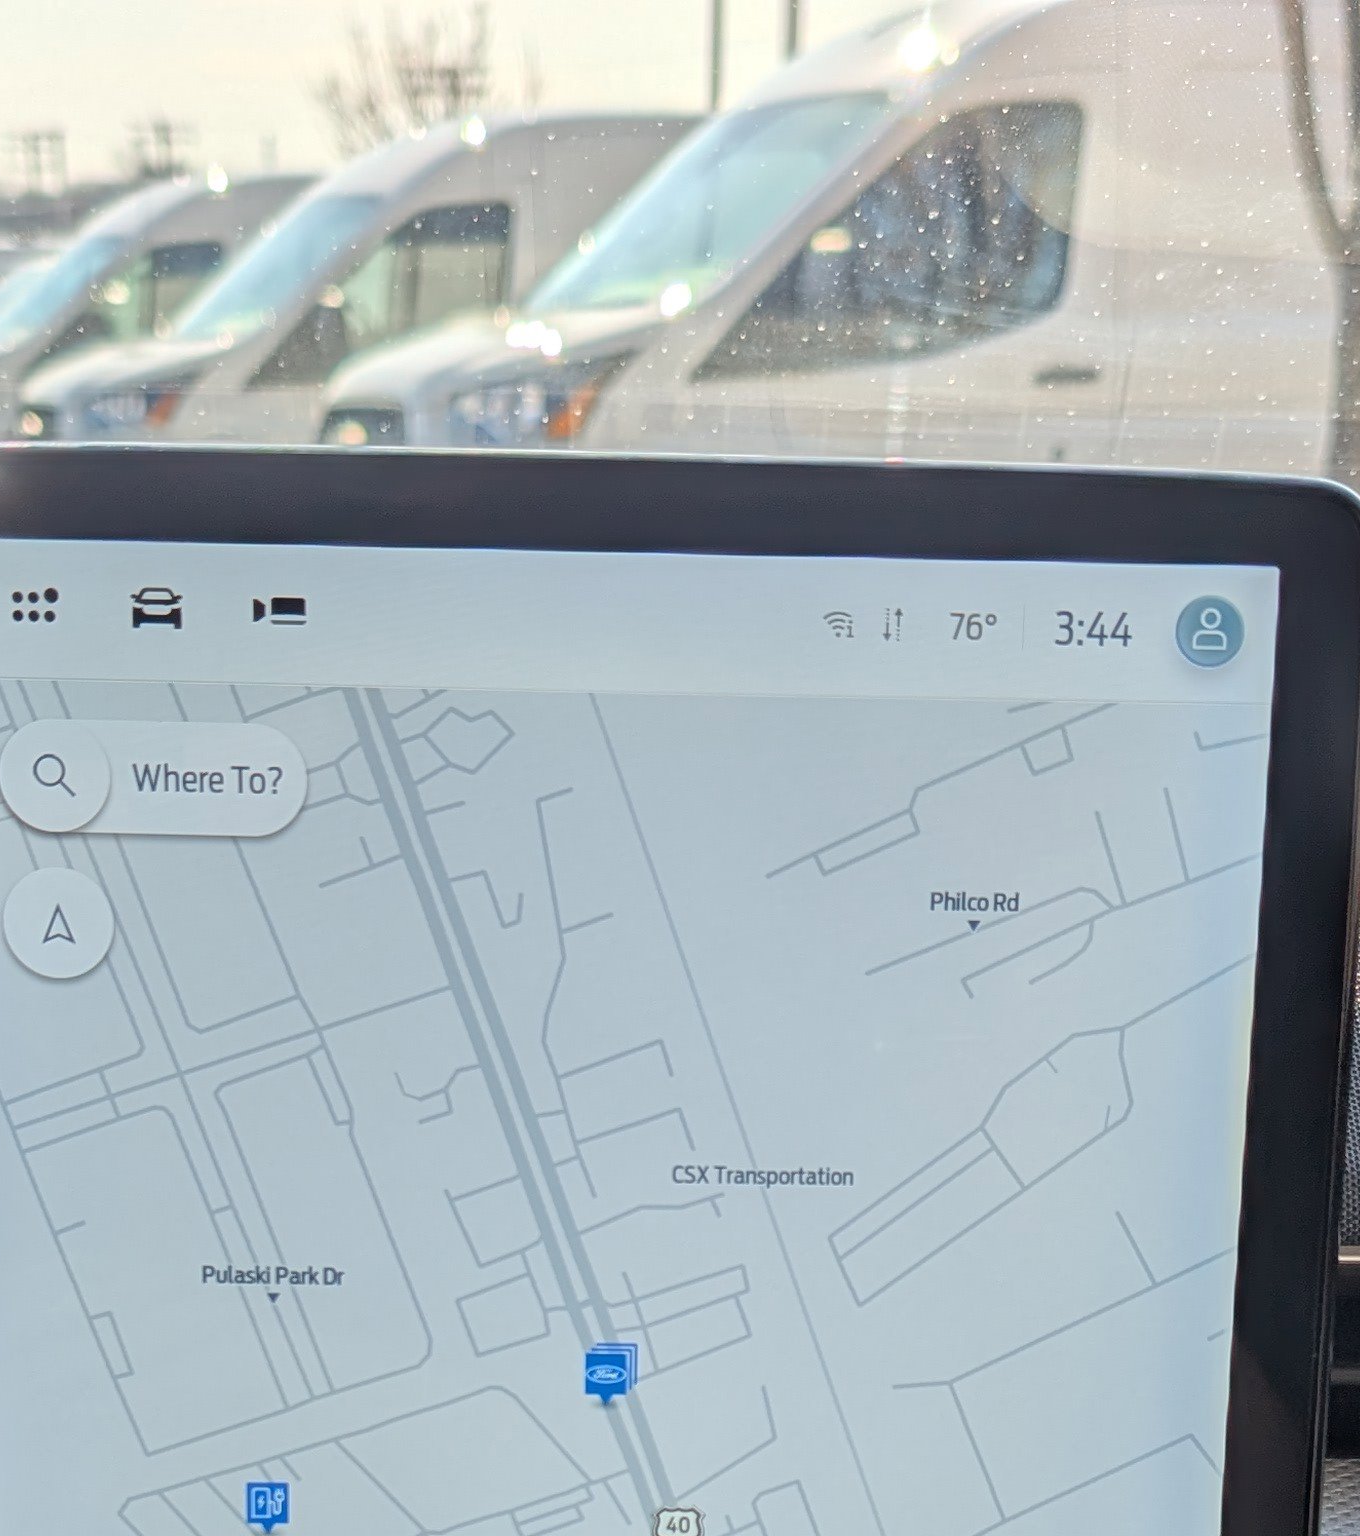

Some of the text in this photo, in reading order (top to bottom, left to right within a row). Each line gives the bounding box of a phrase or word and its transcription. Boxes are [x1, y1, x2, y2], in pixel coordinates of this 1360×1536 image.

[1054, 610, 1133, 648] 3:44
[132, 762, 283, 795] Where To?
[930, 891, 1020, 912] Philco Rd
[672, 1164, 854, 1188] CSX Transportation
[201, 1264, 345, 1286] Pulaski Park Dr
[665, 1516, 691, 1534] 40
